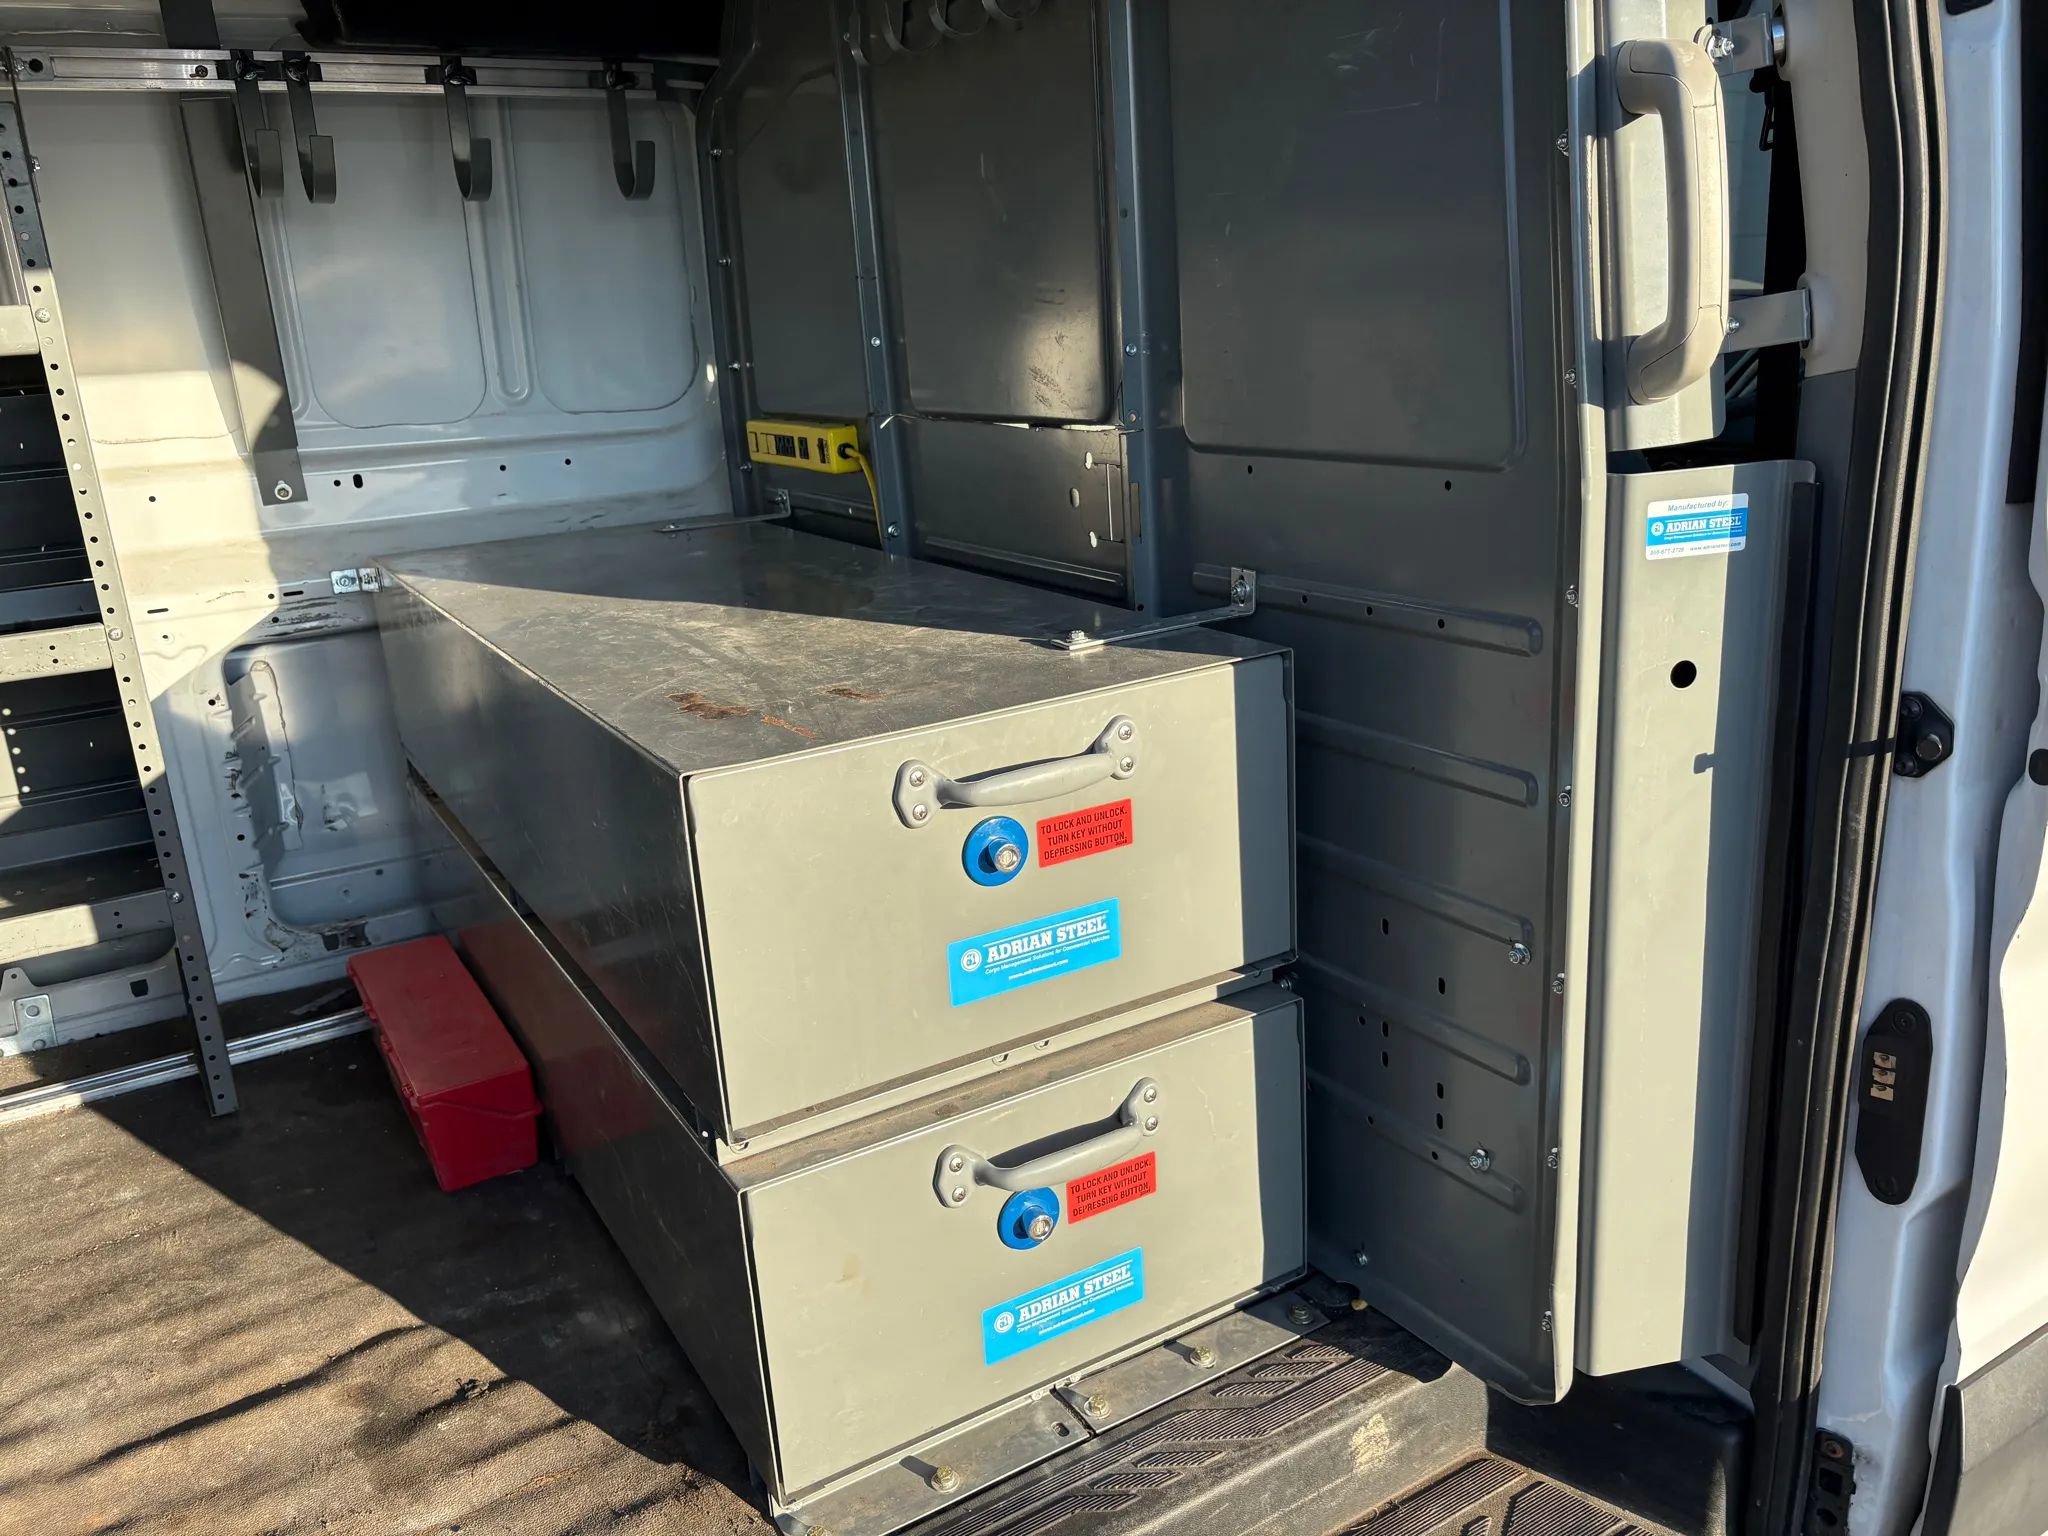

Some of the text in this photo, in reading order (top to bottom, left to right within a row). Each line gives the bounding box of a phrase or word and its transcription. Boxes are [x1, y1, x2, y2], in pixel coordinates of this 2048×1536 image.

[1668, 502, 1716, 512] Manufactured
[1666, 516, 1742, 533] ADRIAN STEEL
[1041, 825, 1051, 835] TO
[1054, 819, 1075, 832] LOCK
[1076, 814, 1092, 827] AND
[1048, 819, 1123, 846] TURN KEY WITHOUT
[1044, 840, 1093, 860] DEPRESSING
[987, 916, 1107, 963] ADRIAN STEEL
[1070, 1184, 1080, 1194] TO
[1082, 1176, 1102, 1190] LOCK
[1103, 1170, 1118, 1183] AND
[1076, 1171, 1147, 1204] TURN KEY WITHOUT
[1073, 1193, 1118, 1217] DEPRESSING
[1018, 1285, 1081, 1323] ADRIAN
[1084, 1265, 1131, 1295] STEEL
